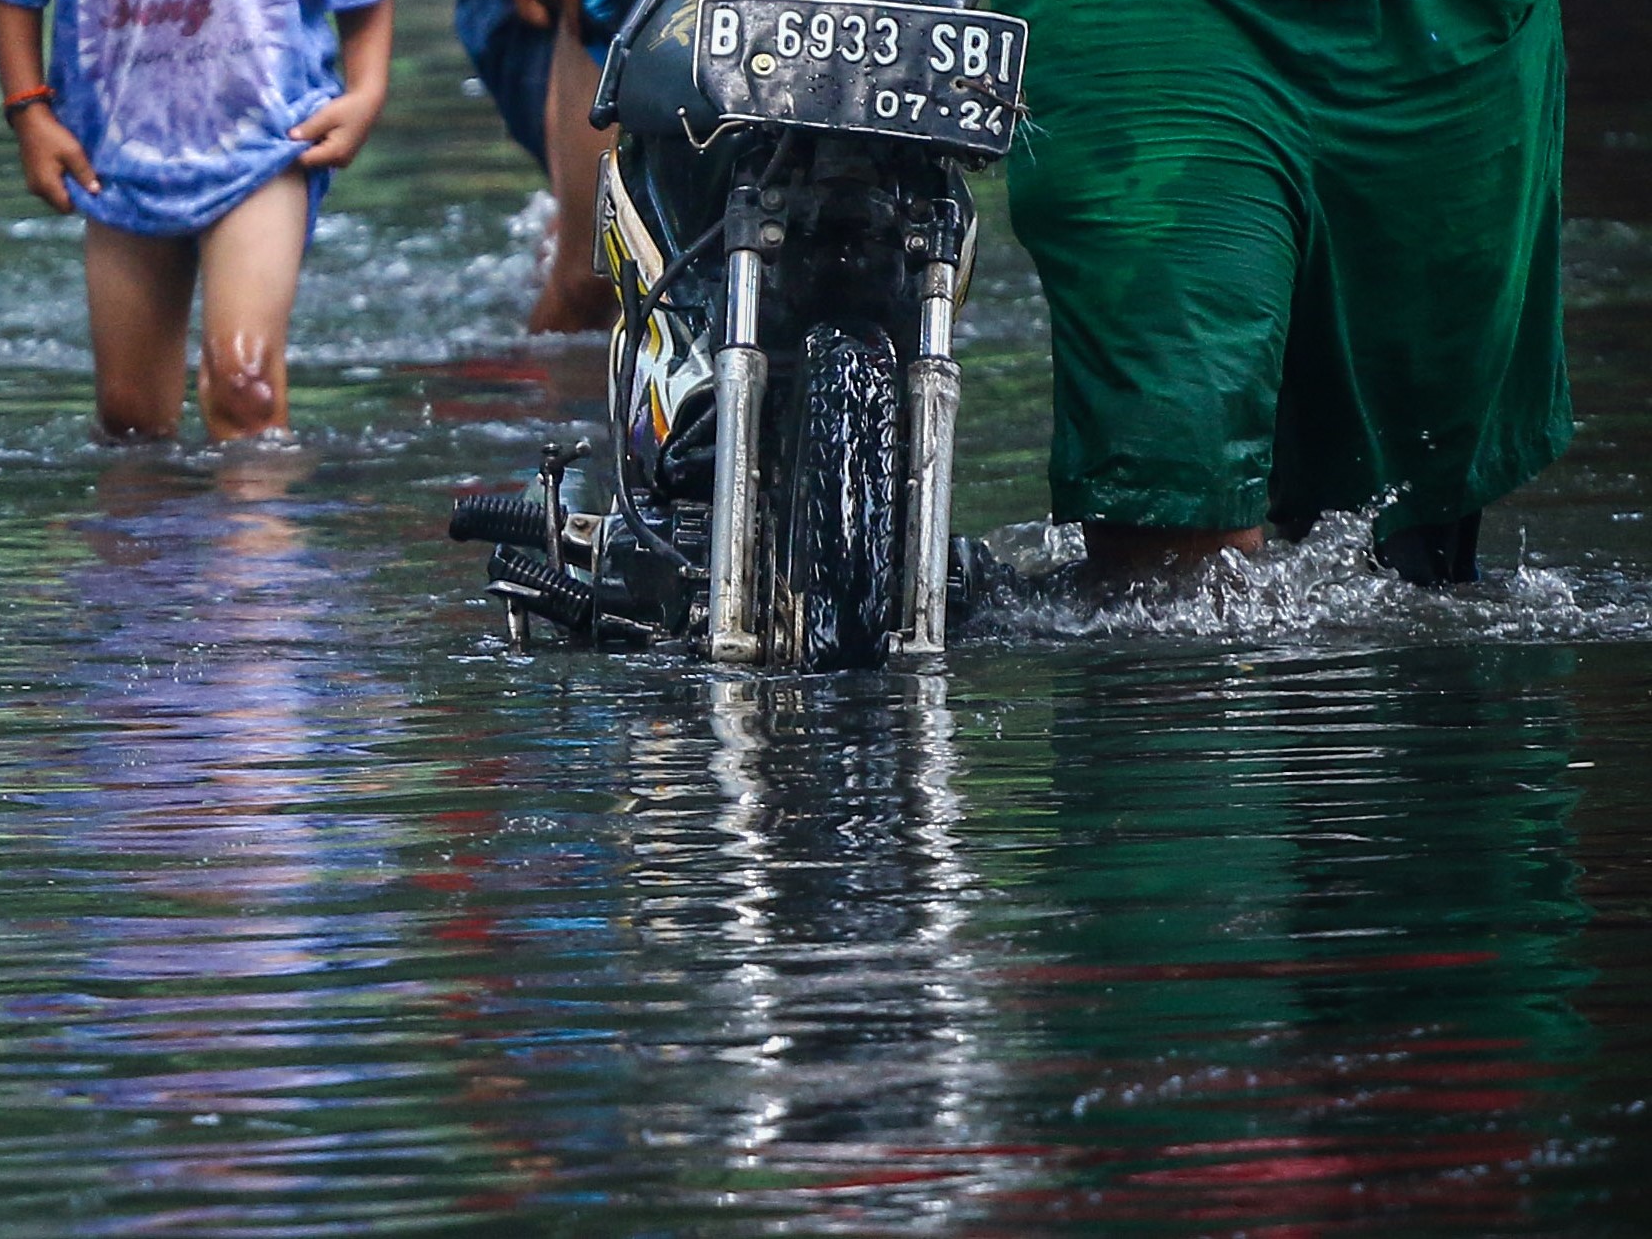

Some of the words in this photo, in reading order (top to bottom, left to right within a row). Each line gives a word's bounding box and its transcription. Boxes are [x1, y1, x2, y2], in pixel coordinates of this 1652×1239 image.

[711, 8, 740, 57] B
[776, 11, 900, 66] 6933
[929, 23, 1015, 84] SBI
